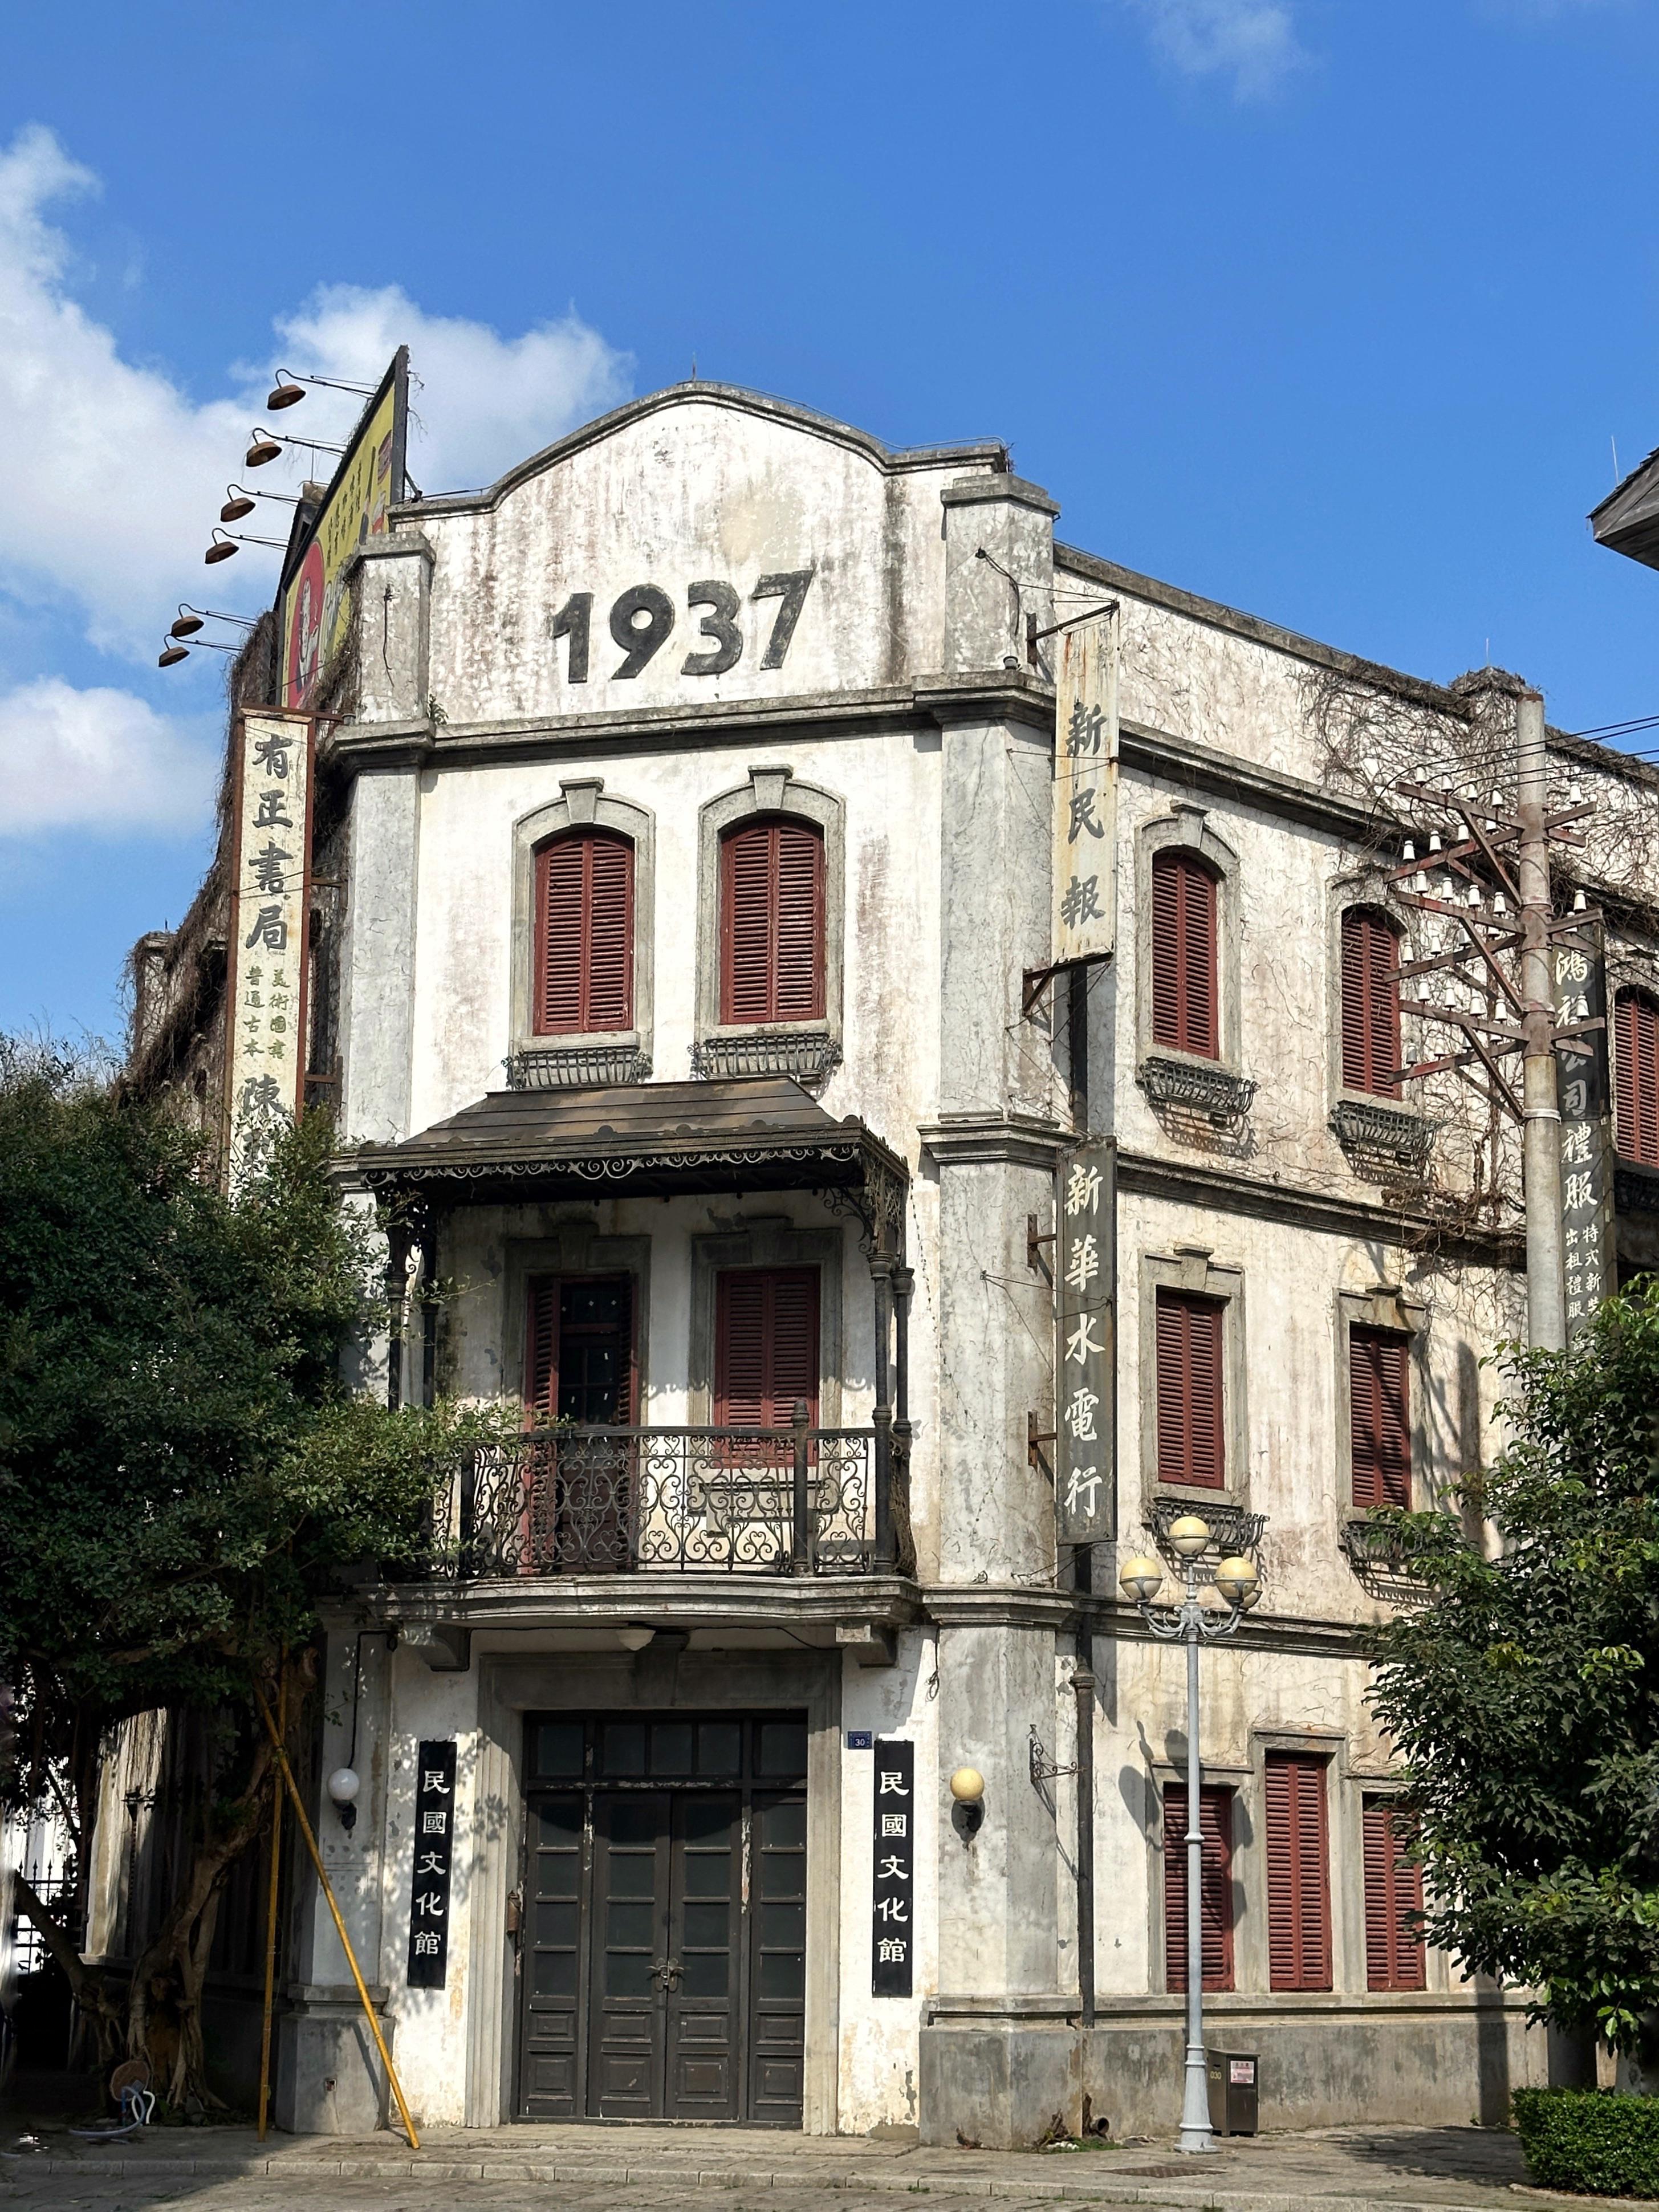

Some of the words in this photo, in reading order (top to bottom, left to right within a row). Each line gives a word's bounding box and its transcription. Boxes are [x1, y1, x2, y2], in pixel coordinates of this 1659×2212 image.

[552, 570, 813, 684] 1937
[245, 733, 294, 951] 有正書局
[1061, 703, 1106, 930] 新民報
[242, 965, 265, 1058] 普通古本
[1064, 1164, 1105, 1517] 新華水電行
[1565, 1228, 1585, 1319] 出租禮服
[414, 1771, 450, 1955] 民國文化館
[877, 1771, 910, 1963] 民國文化館
